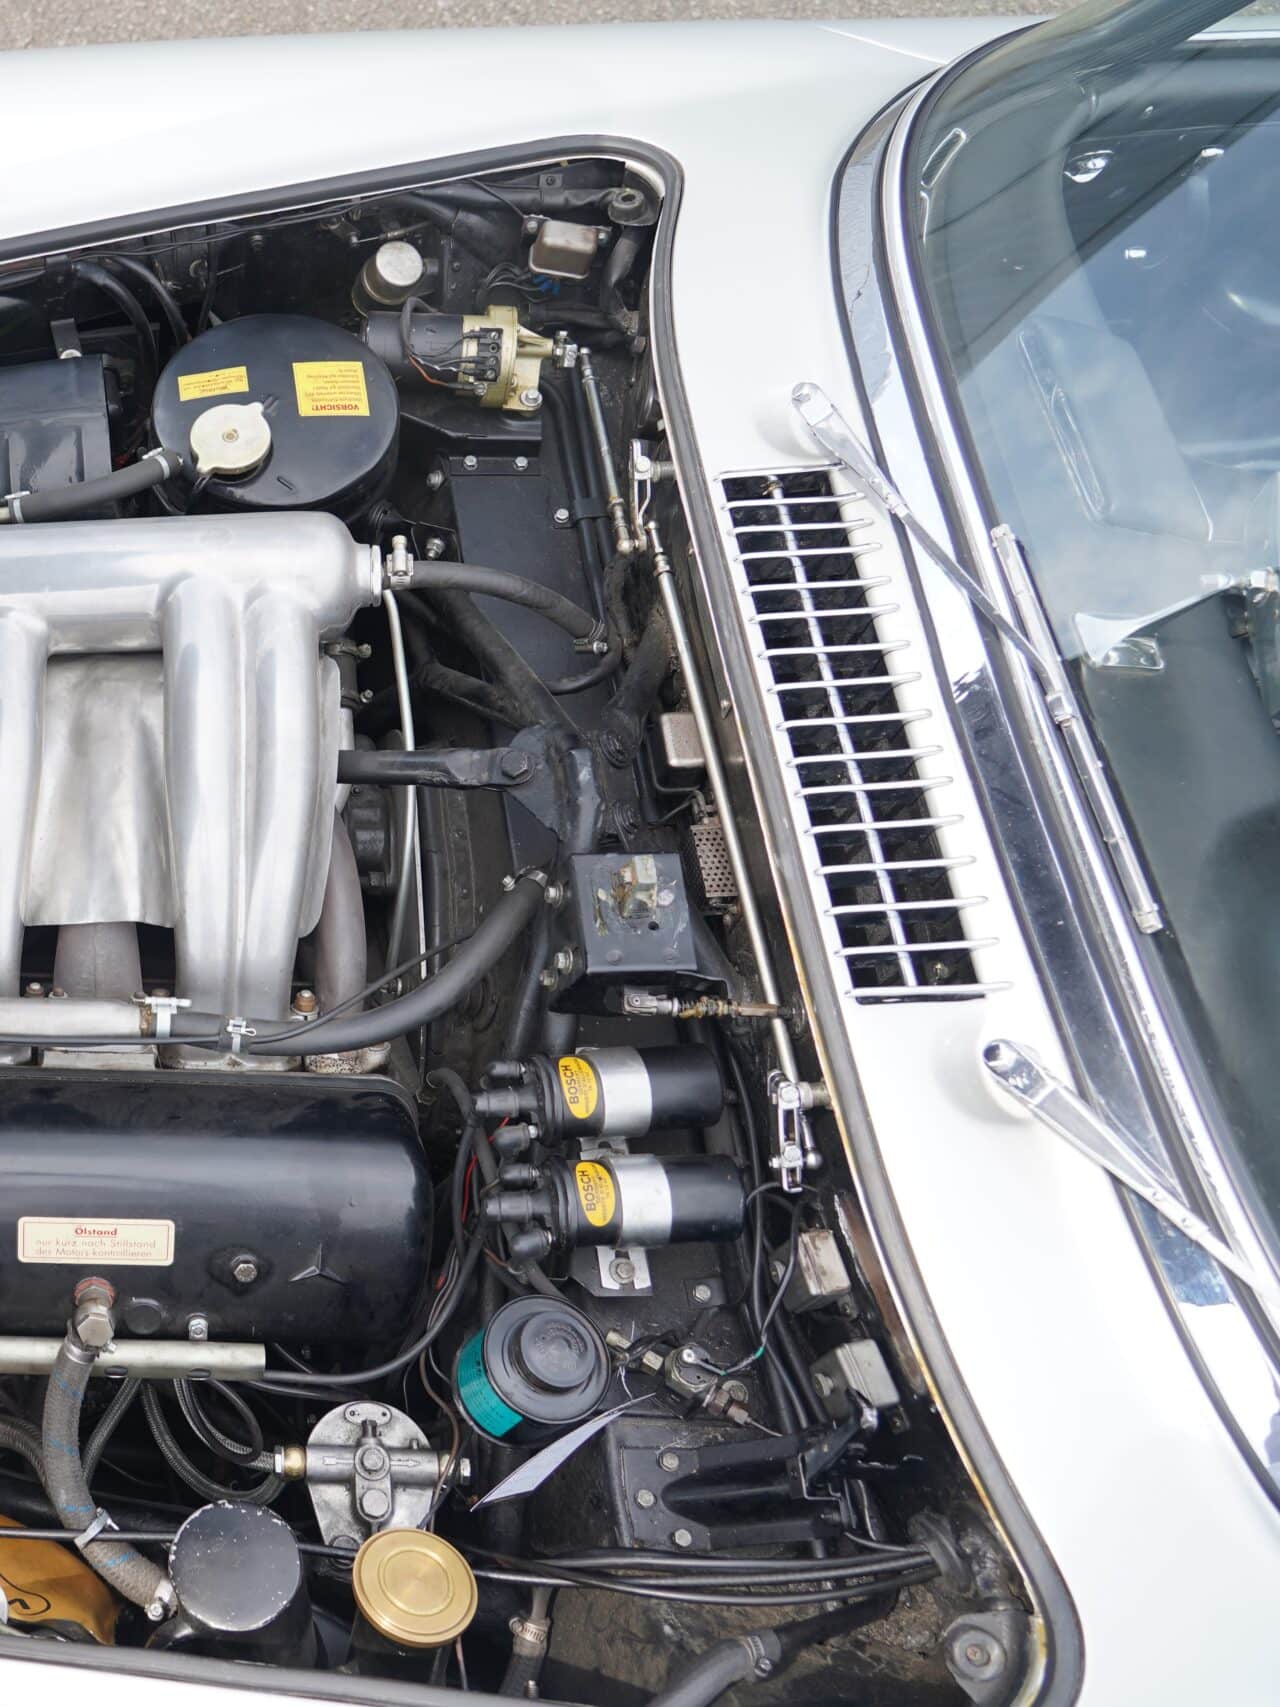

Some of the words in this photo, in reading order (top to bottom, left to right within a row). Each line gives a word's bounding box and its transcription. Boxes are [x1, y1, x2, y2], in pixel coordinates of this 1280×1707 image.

[312, 403, 360, 412] VORSICHT!
[561, 1064, 579, 1105] BOSCH
[578, 1169, 597, 1212] BOSCH
[74, 1225, 119, 1236] Ölstand
[56, 1238, 77, 1246] kurz
[82, 1238, 106, 1247] nach
[110, 1239, 157, 1249] Stillstand
[55, 1247, 89, 1257] Motors
[92, 1248, 152, 1258] kontrollieren
